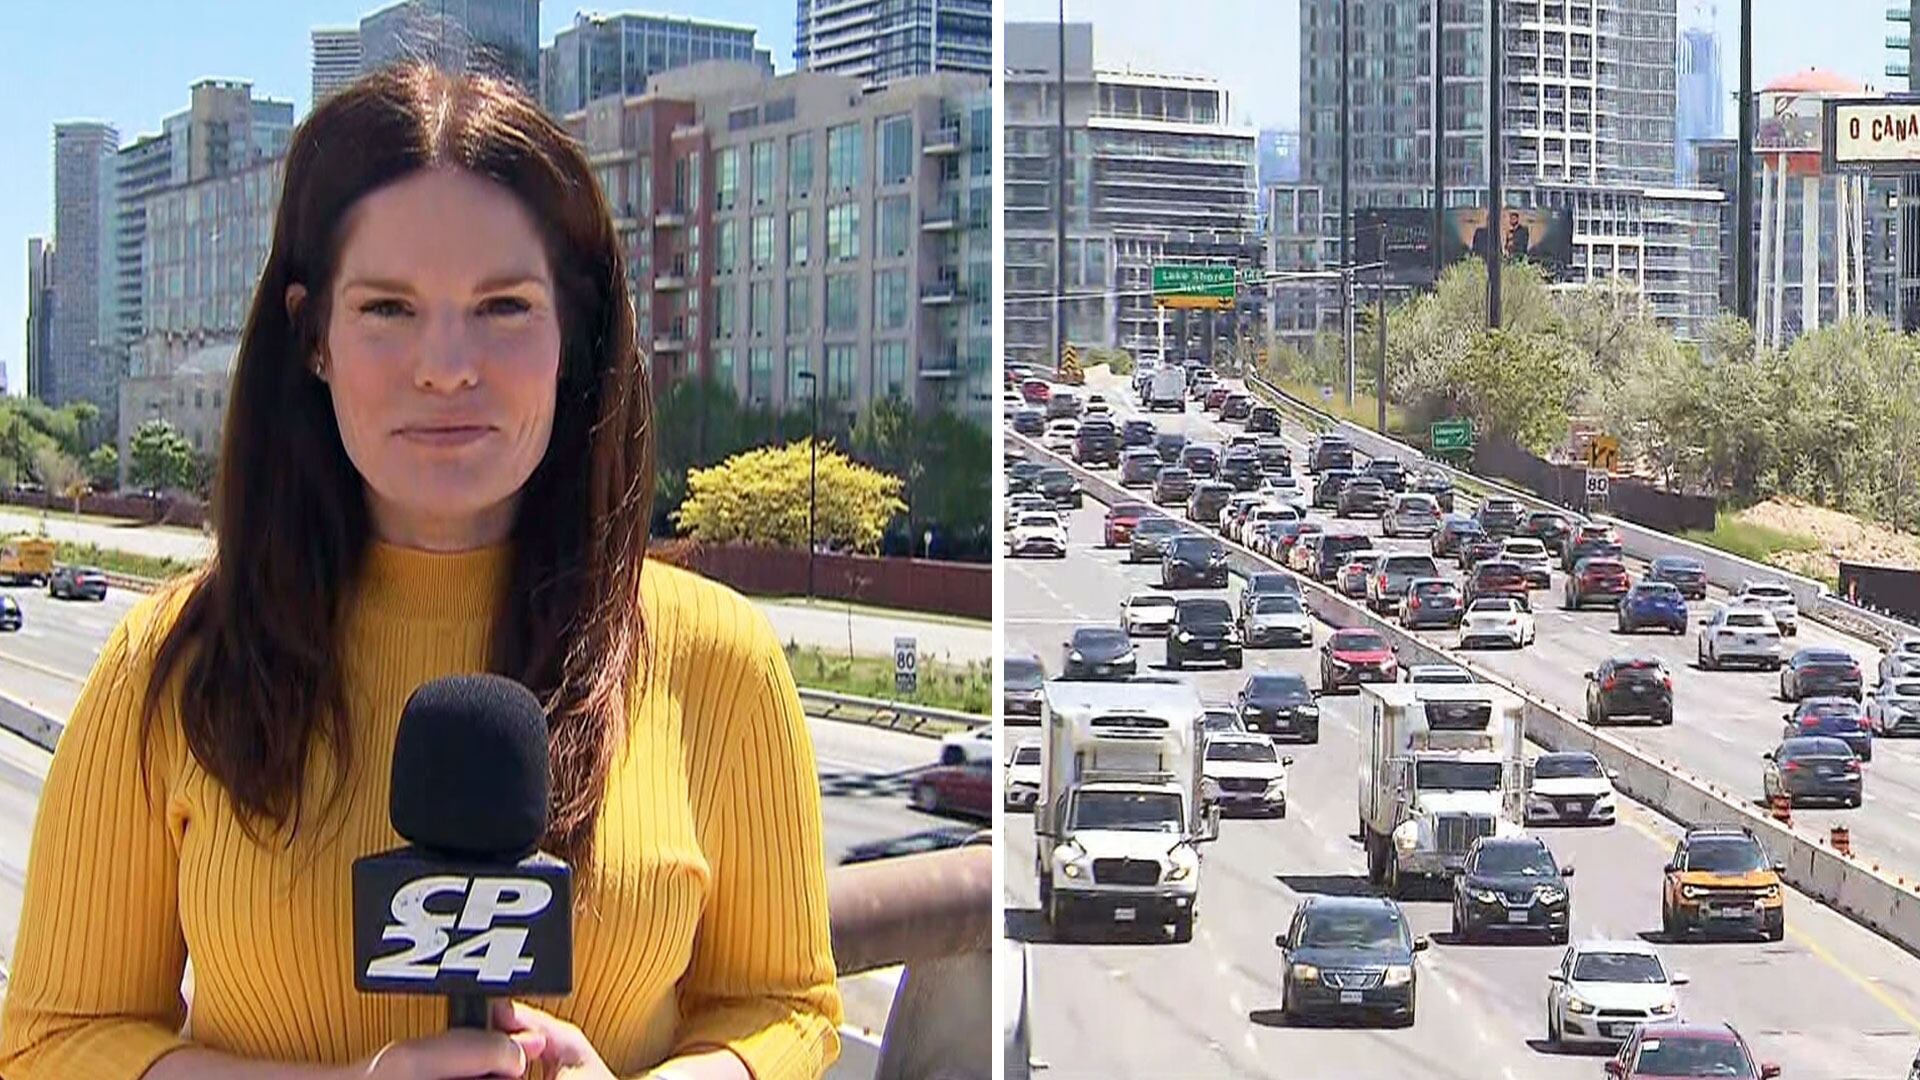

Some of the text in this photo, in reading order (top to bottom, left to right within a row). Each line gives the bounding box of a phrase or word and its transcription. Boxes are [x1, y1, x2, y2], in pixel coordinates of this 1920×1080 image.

[1850, 114, 1918, 142] O CANA
[1162, 270, 1225, 282] Lake Shore
[1587, 477, 1607, 492] 80
[897, 651, 915, 670] 80
[391, 876, 553, 930] CP
[366, 924, 535, 982] 24
